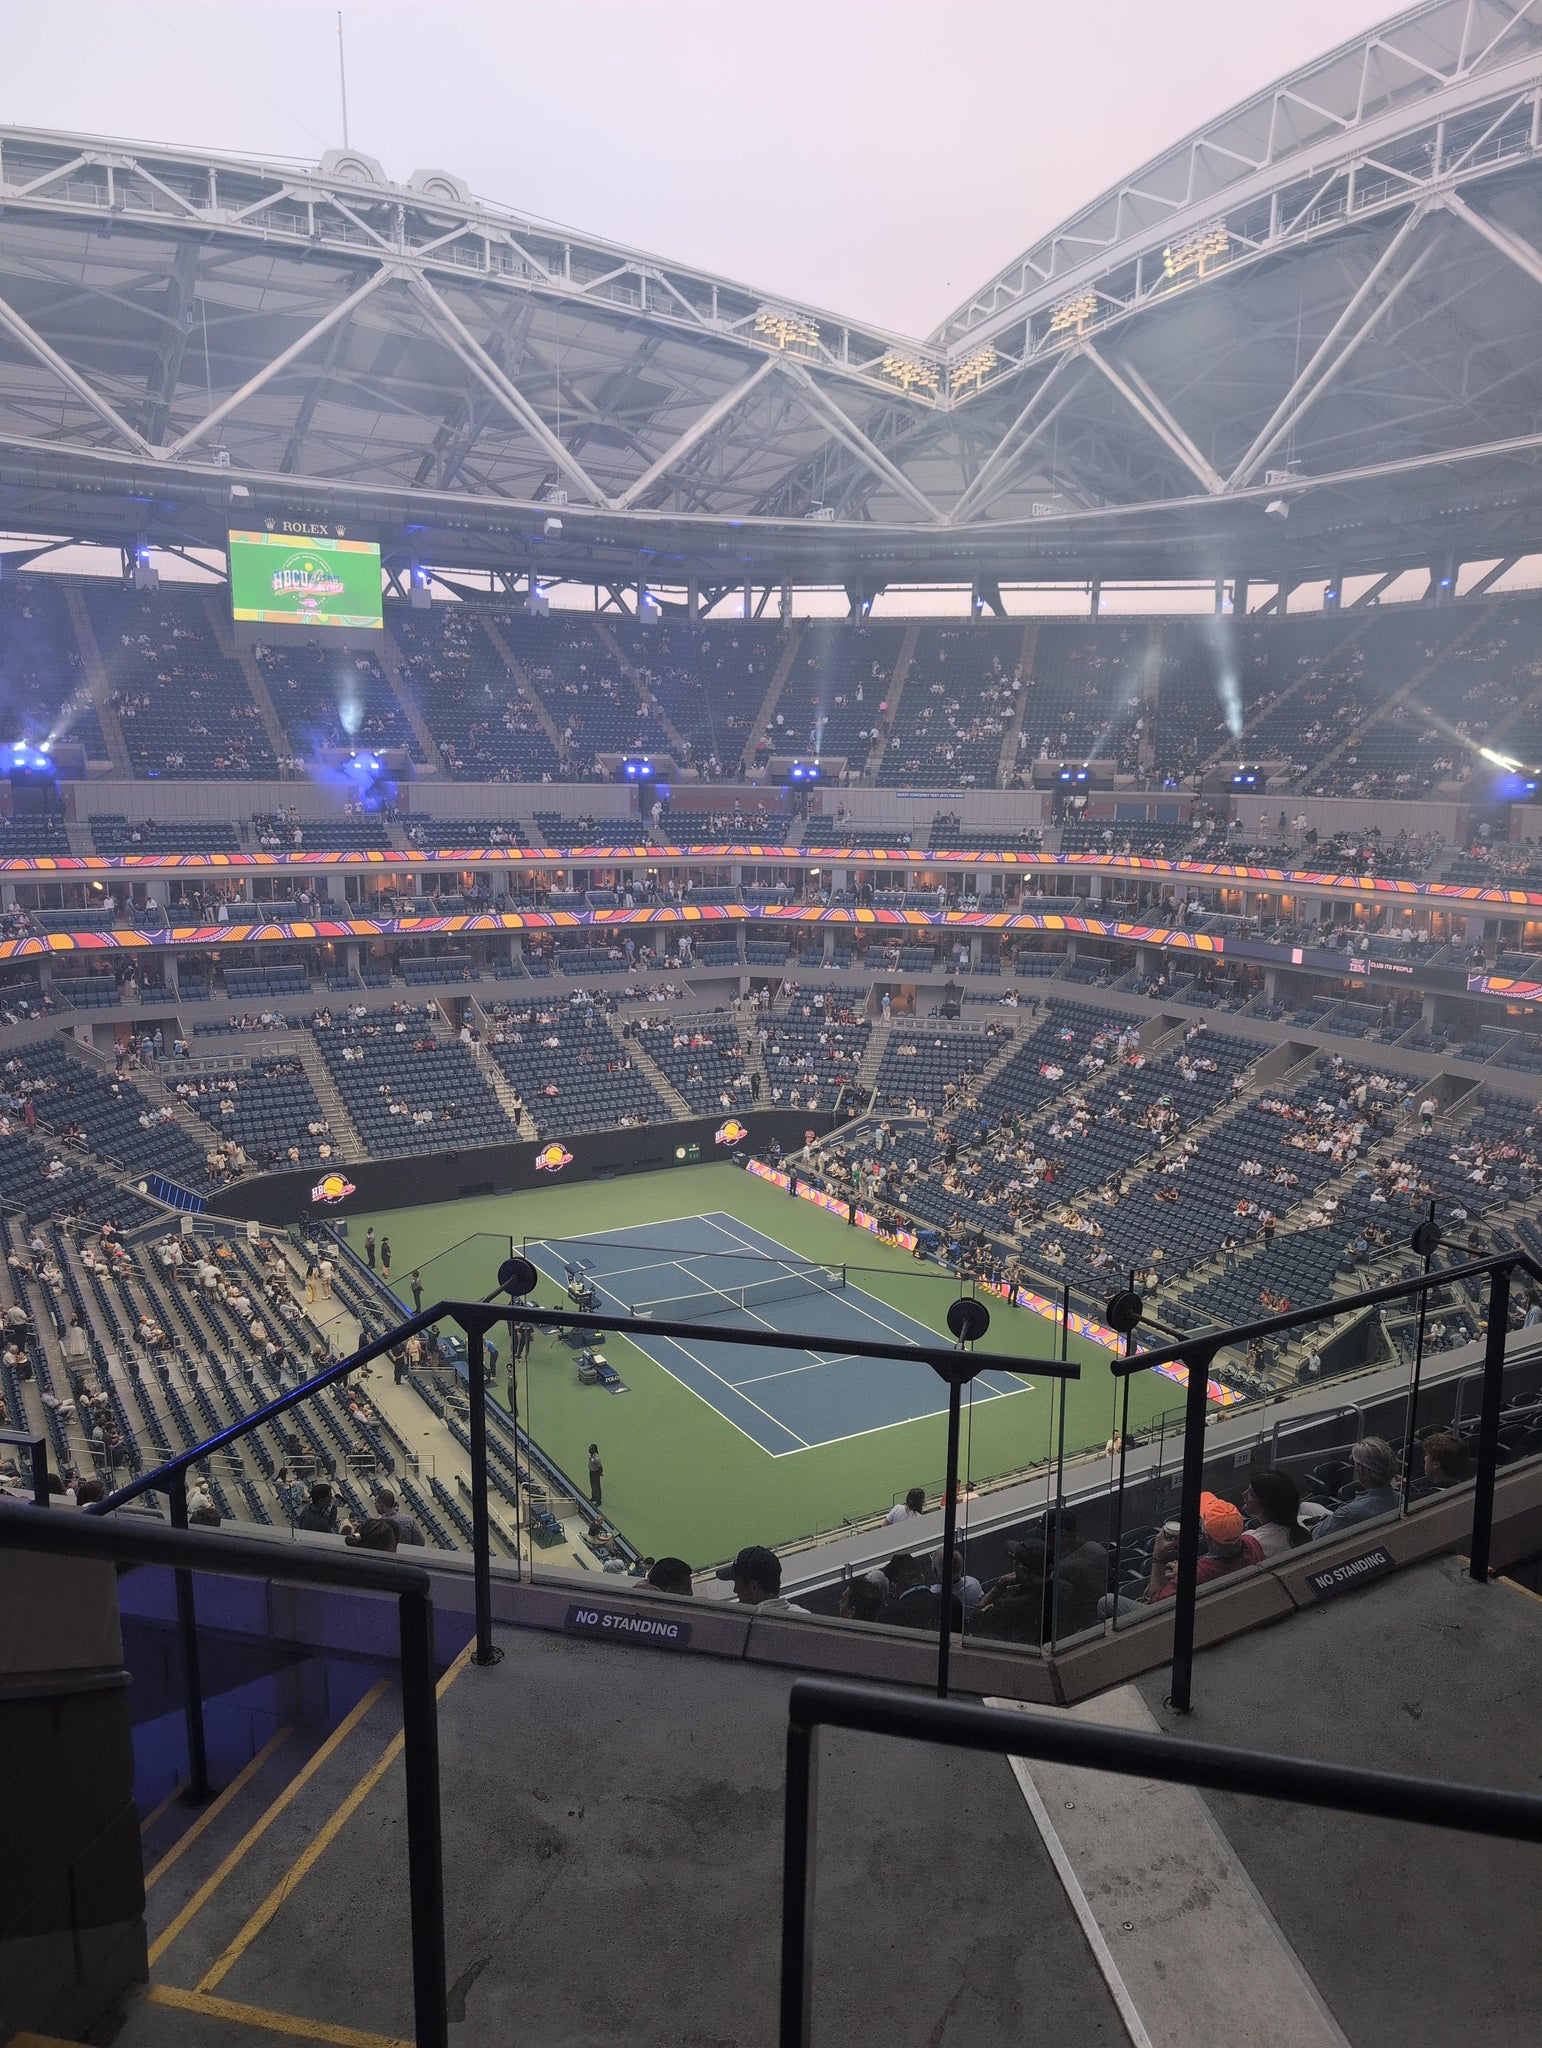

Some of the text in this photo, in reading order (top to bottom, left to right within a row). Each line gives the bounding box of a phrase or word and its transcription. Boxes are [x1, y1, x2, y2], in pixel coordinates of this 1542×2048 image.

[283, 521, 329, 535] ROLEX
[1349, 963, 1366, 973] IBM
[1393, 965, 1413, 974] PEOPLE
[605, 1374, 620, 1383] POLO
[1314, 1552, 1386, 1589] NO STANDING
[575, 1610, 678, 1638] NO STANDING
